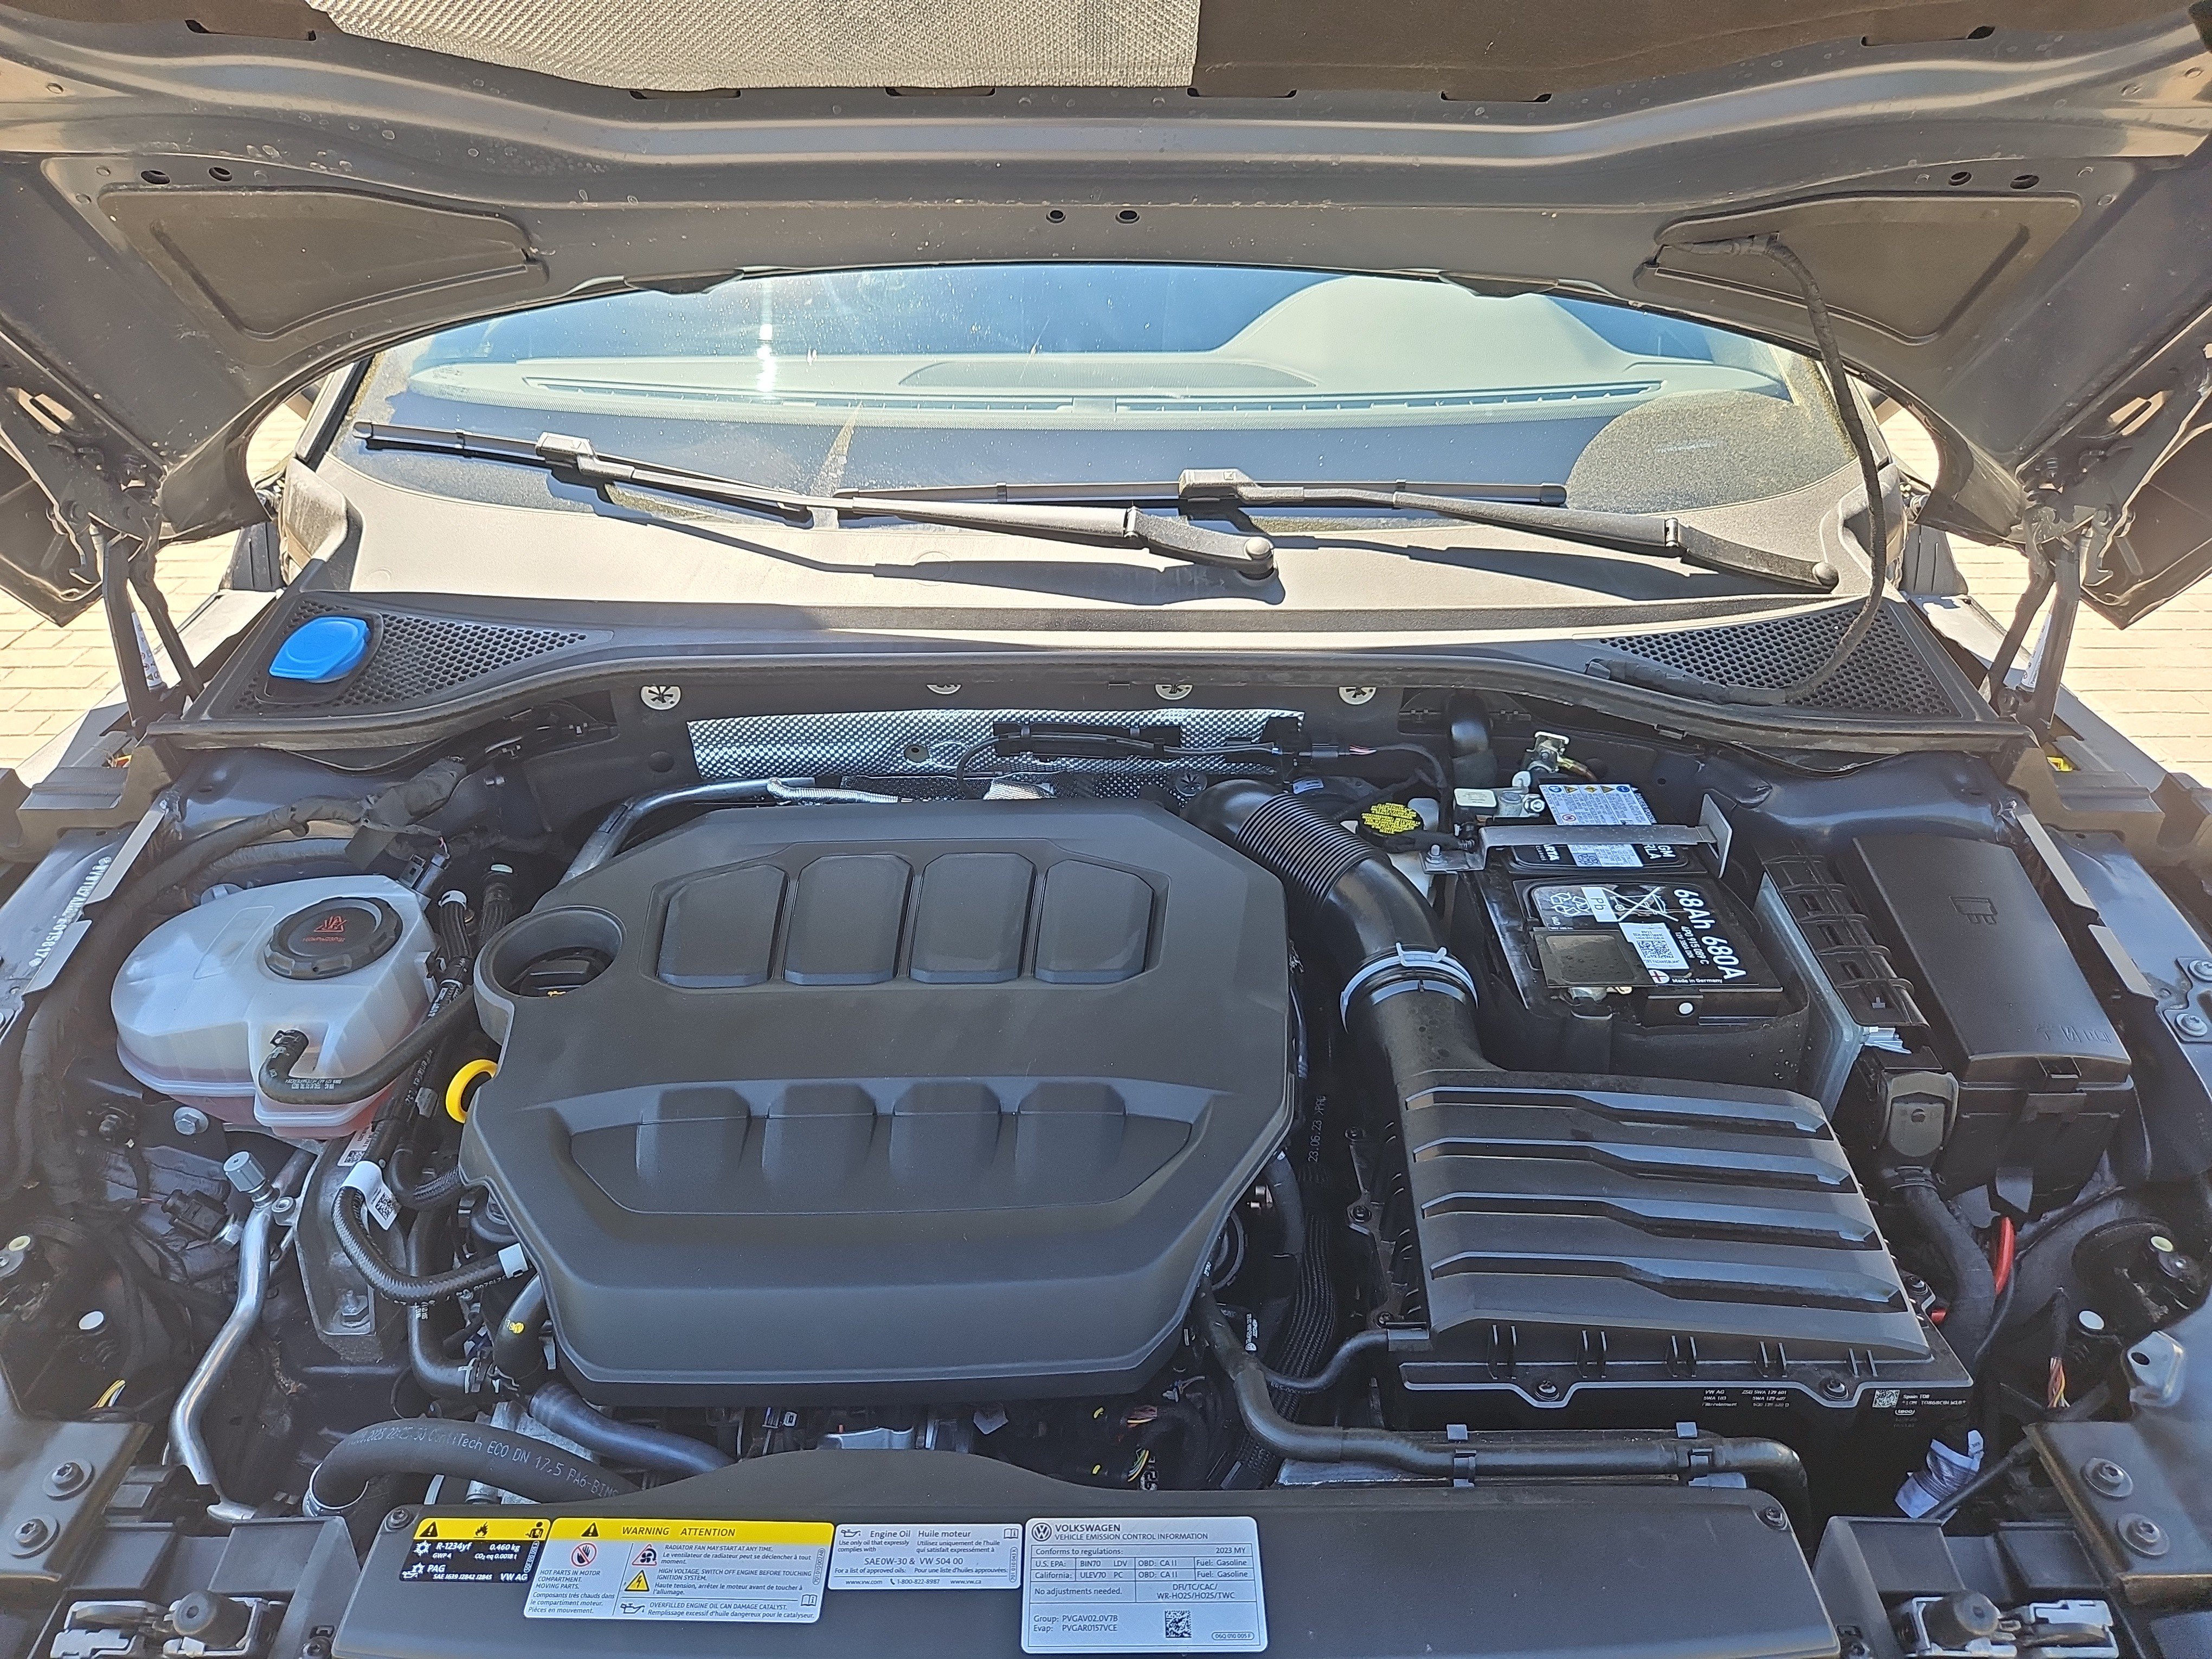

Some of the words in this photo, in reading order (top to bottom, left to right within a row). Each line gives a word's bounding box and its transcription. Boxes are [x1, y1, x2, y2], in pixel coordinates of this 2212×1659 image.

[1544, 844, 1560, 861] RTA
[1643, 844, 1662, 859] RLA
[1658, 845, 1676, 857] GM
[1591, 898, 1606, 910] Pb
[1674, 889, 1715, 929] 68Ah
[1701, 936, 1746, 980] 680A
[1308, 1120, 1322, 1162] 23.06.23
[487, 1441, 509, 1458] ECO
[512, 1447, 531, 1463] DN
[622, 1526, 670, 1535] WARNING
[680, 1527, 736, 1536] ATTENTION
[1055, 1524, 1121, 1532] VOLKSWAGEN
[870, 1530, 898, 1540] Engine
[918, 1529, 940, 1538] Huile
[436, 1542, 472, 1552] R-1234yf
[1081, 1547, 1123, 1557] regulations:
[1196, 1558, 1213, 1566] Fuel:
[866, 1567, 894, 1575] approved
[1196, 1570, 1214, 1579] Fuel:
[532, 1591, 568, 1600] Composants
[1046, 1587, 1092, 1597] adjustments
[537, 1598, 580, 1606] compartiment
[647, 1609, 685, 1617] Remplissage
[730, 1610, 762, 1618] dangereux
[783, 1611, 814, 1619] catalyseur.
[1033, 1615, 1059, 1624] Group:
